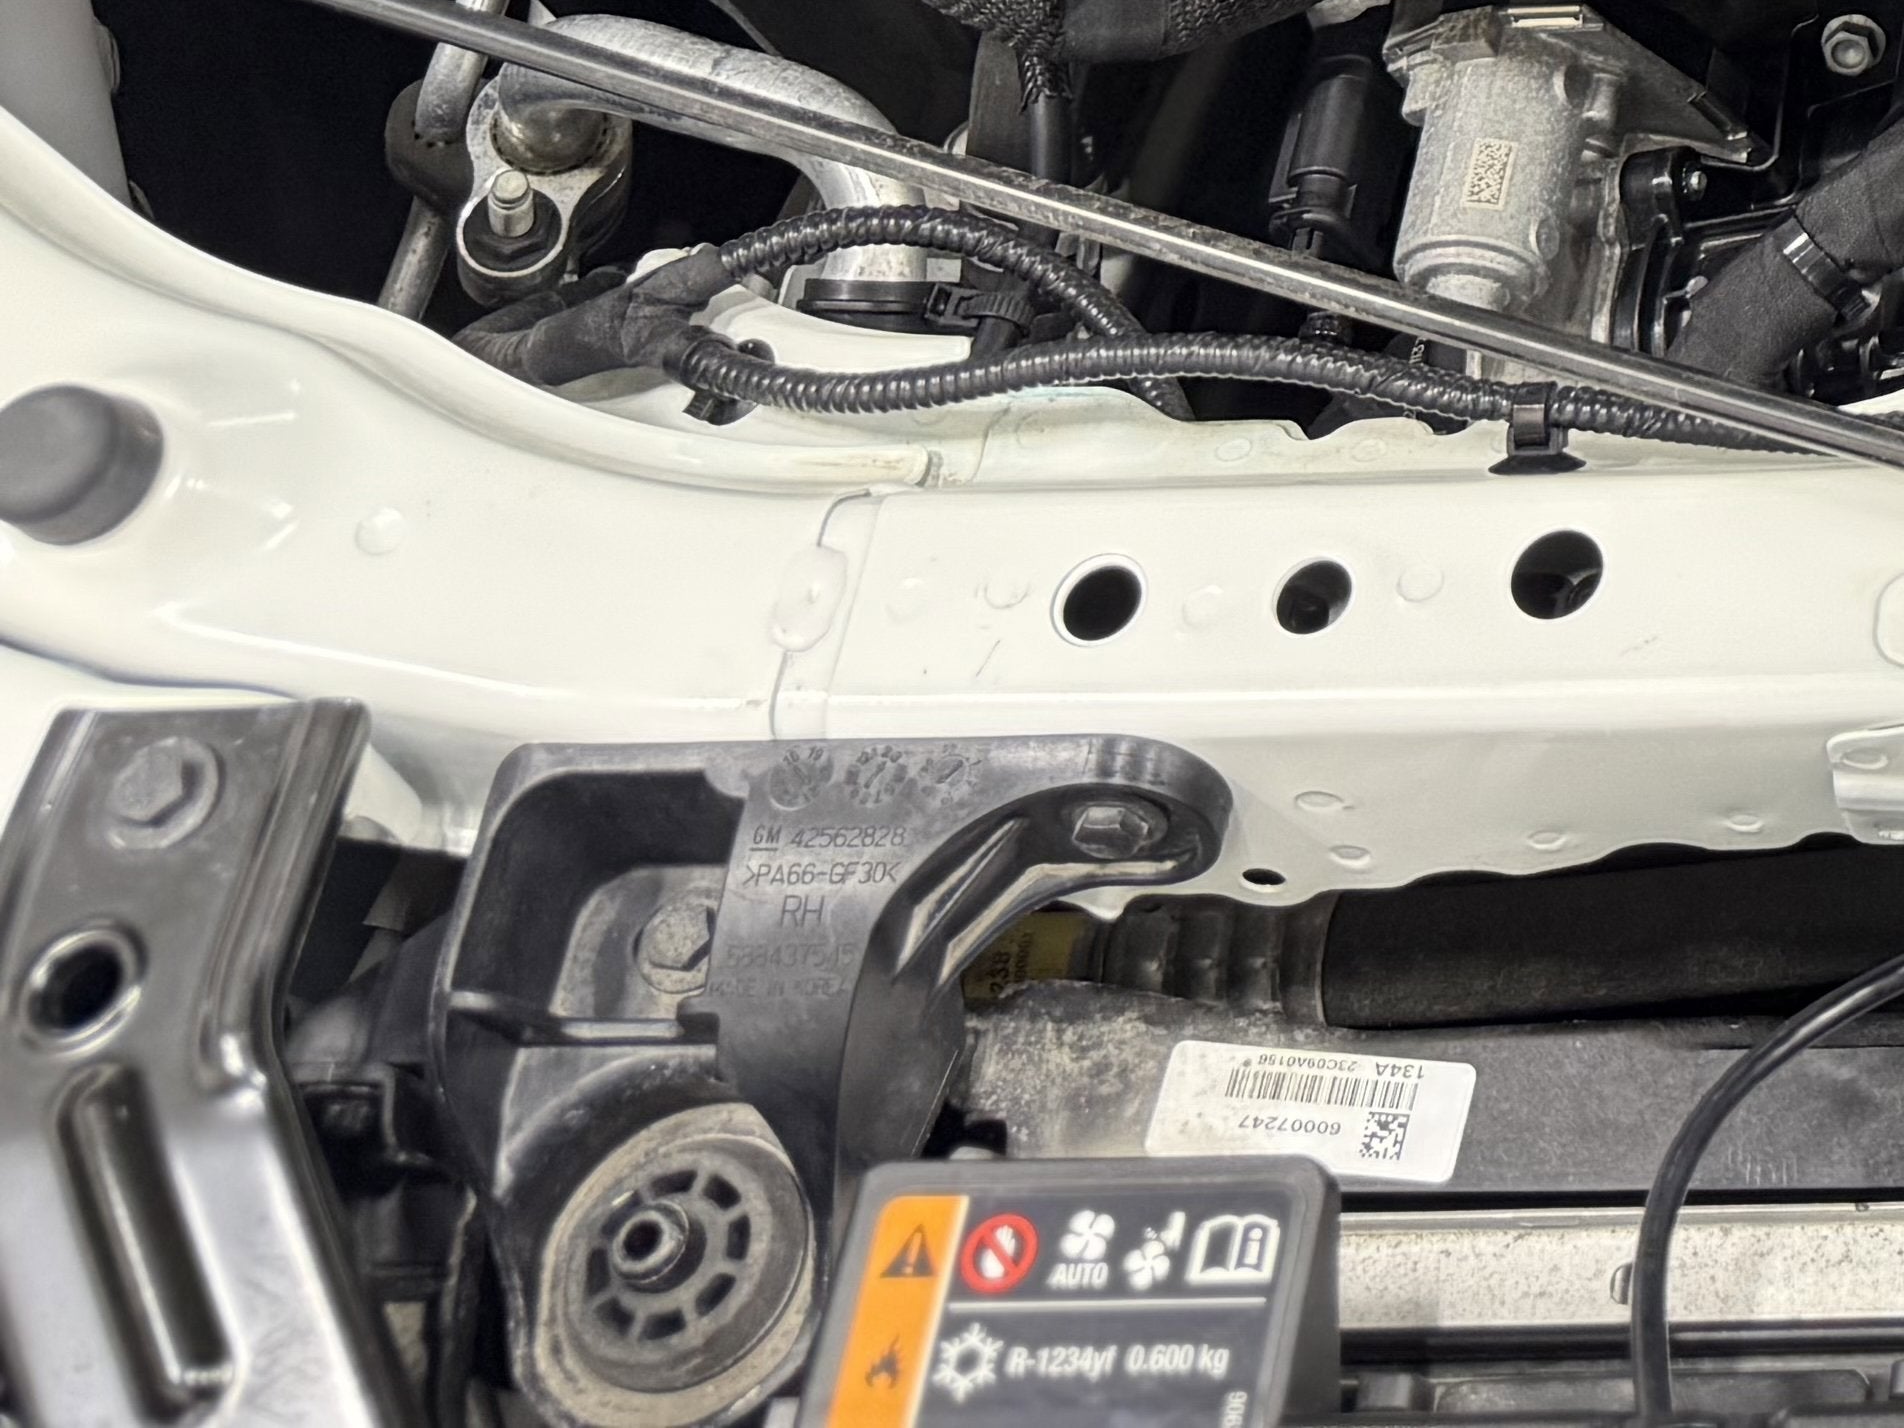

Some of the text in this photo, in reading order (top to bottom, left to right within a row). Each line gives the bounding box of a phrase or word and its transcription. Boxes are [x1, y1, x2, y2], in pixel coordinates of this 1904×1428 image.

[750, 824, 907, 852] GM 42562828
[781, 896, 825, 928] RH
[1373, 1061, 1426, 1081] 134A
[1237, 1113, 1342, 1138] 60007247
[1049, 1262, 1109, 1289] AUTO
[1005, 1342, 1231, 1378] R-1234yf 0.600 kg
